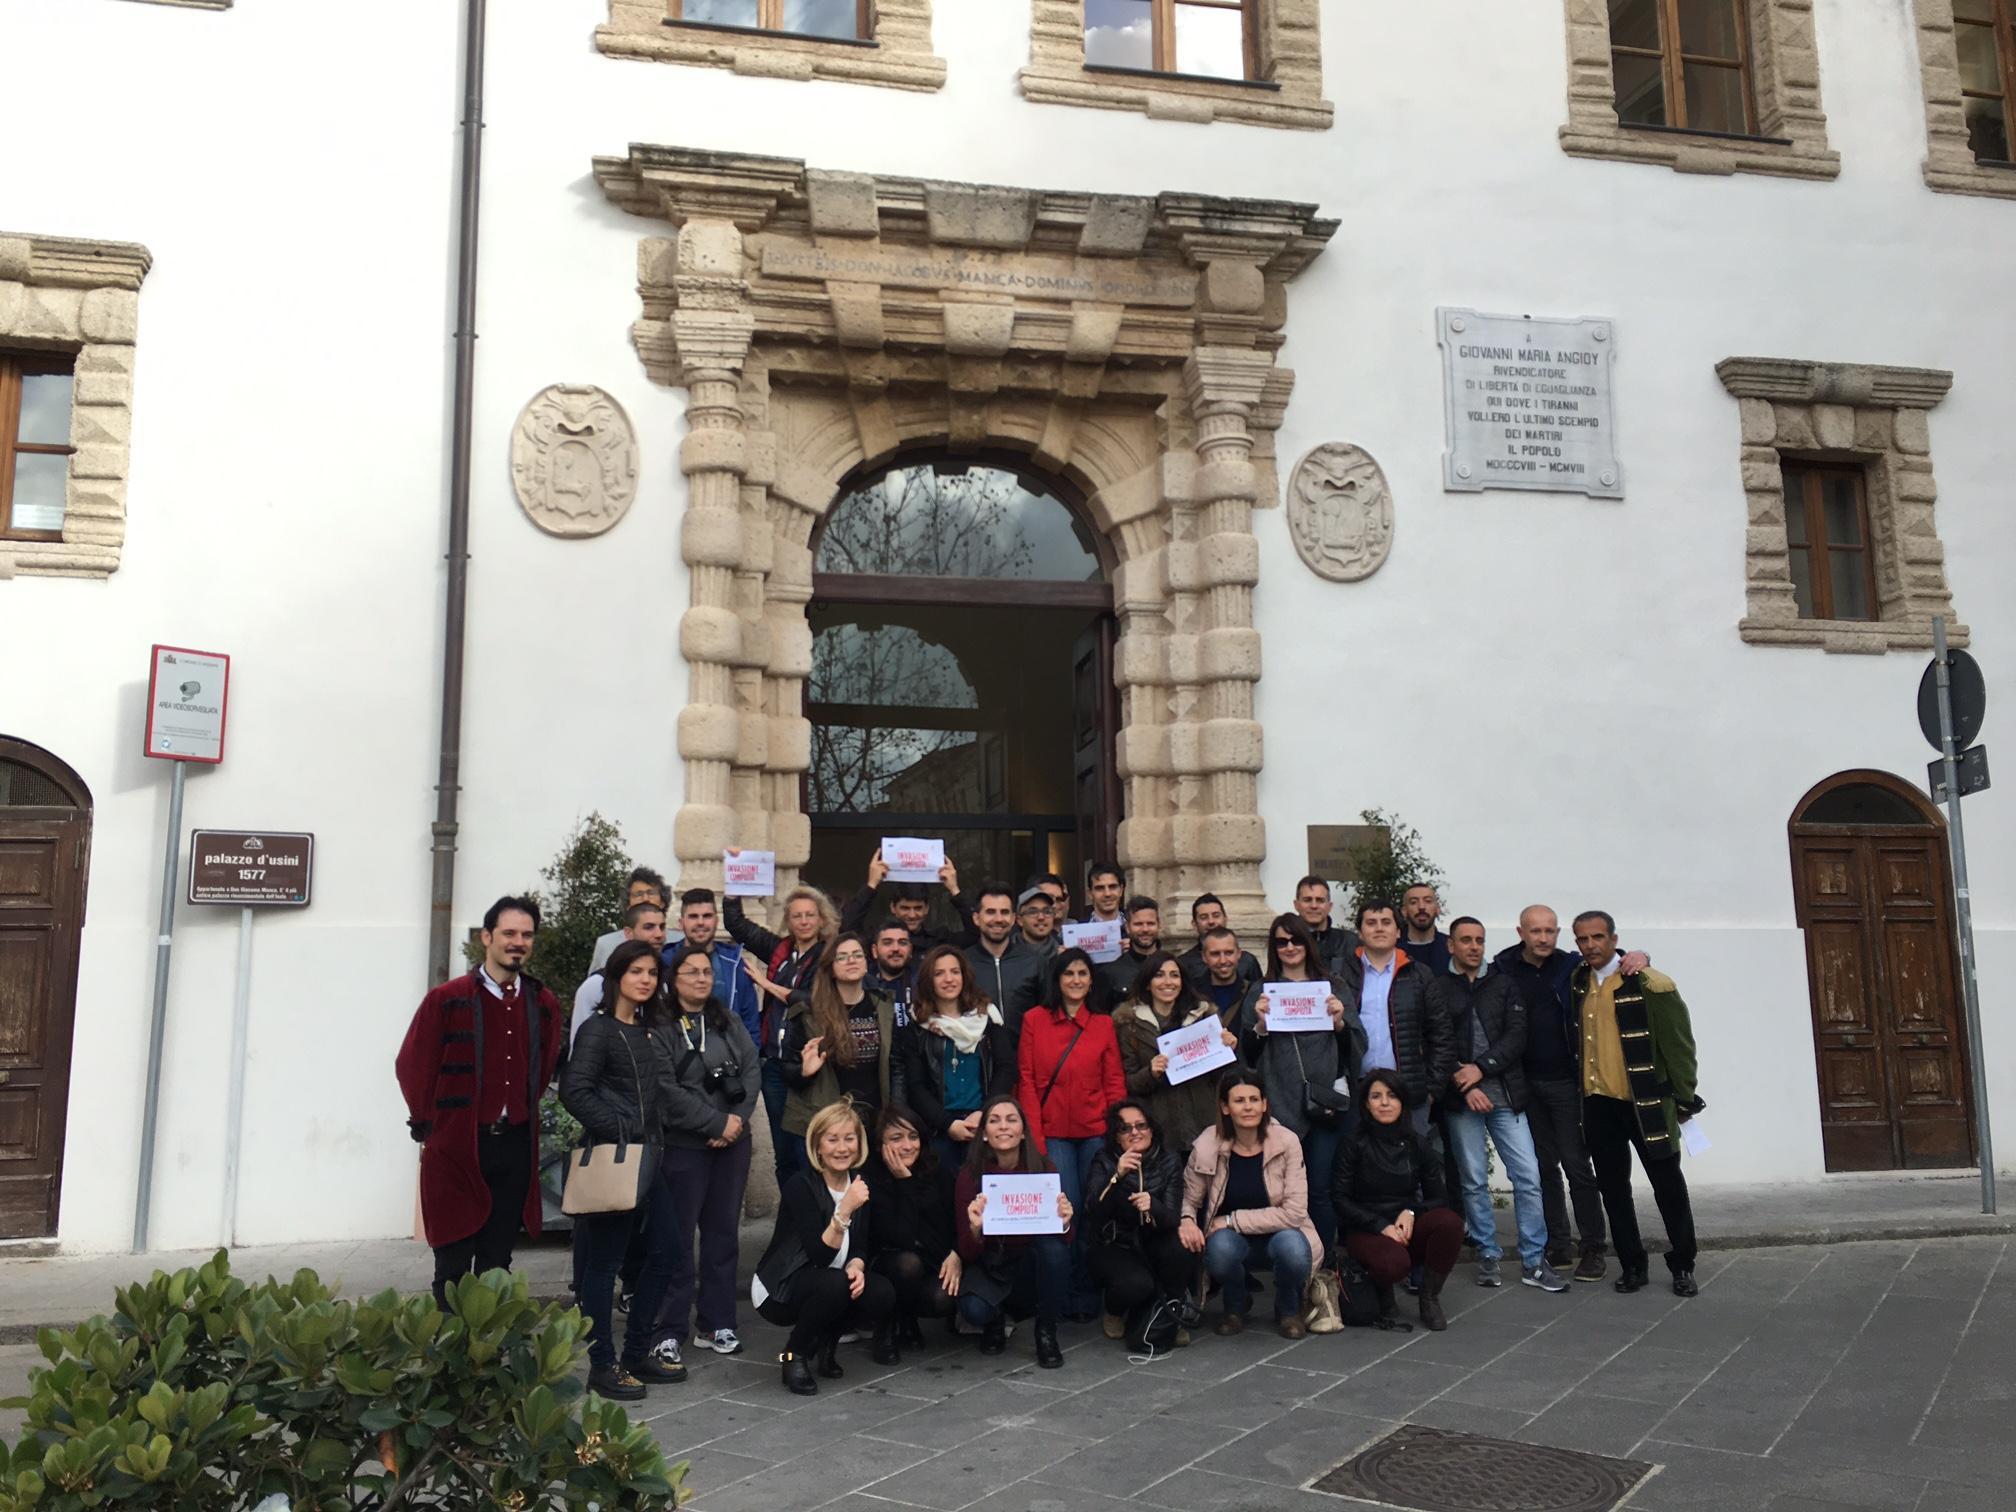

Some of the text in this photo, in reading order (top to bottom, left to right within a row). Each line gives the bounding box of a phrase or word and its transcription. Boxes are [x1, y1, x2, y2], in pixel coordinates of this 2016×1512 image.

[1526, 334, 1533, 343] A
[1459, 345, 1599, 365] GIOVANNI MARIA ANGIOY
[1494, 365, 1567, 379] RIVENDICATORE
[1466, 379, 1475, 389] DI
[1522, 383, 1531, 393] DI
[1535, 384, 1597, 396] EGUAGLIANZA
[1487, 396, 1502, 407] QUI
[1506, 397, 1531, 409] DOVE
[1542, 399, 1578, 411] TIRANNI
[1468, 411, 1511, 423] VOLLERO
[1558, 416, 1599, 428] SCEMPIO
[1505, 429, 1563, 441] DEI MARTIRI
[1508, 444, 1561, 457] IL POPOLO
[1549, 462, 1585, 473] MCMVIII
[204, 853, 299, 866] palazzo d'usini
[238, 869, 266, 880] 1577
[727, 864, 759, 873] INVASIONE
[1281, 997, 1316, 1007] INVASIONE
[1284, 1007, 1313, 1016] COMPIUTA
[1176, 1034, 1210, 1055] INVASIONE
[1002, 1193, 1043, 1204] INVASIONE
[1007, 1205, 1039, 1216] COMPIUTA
